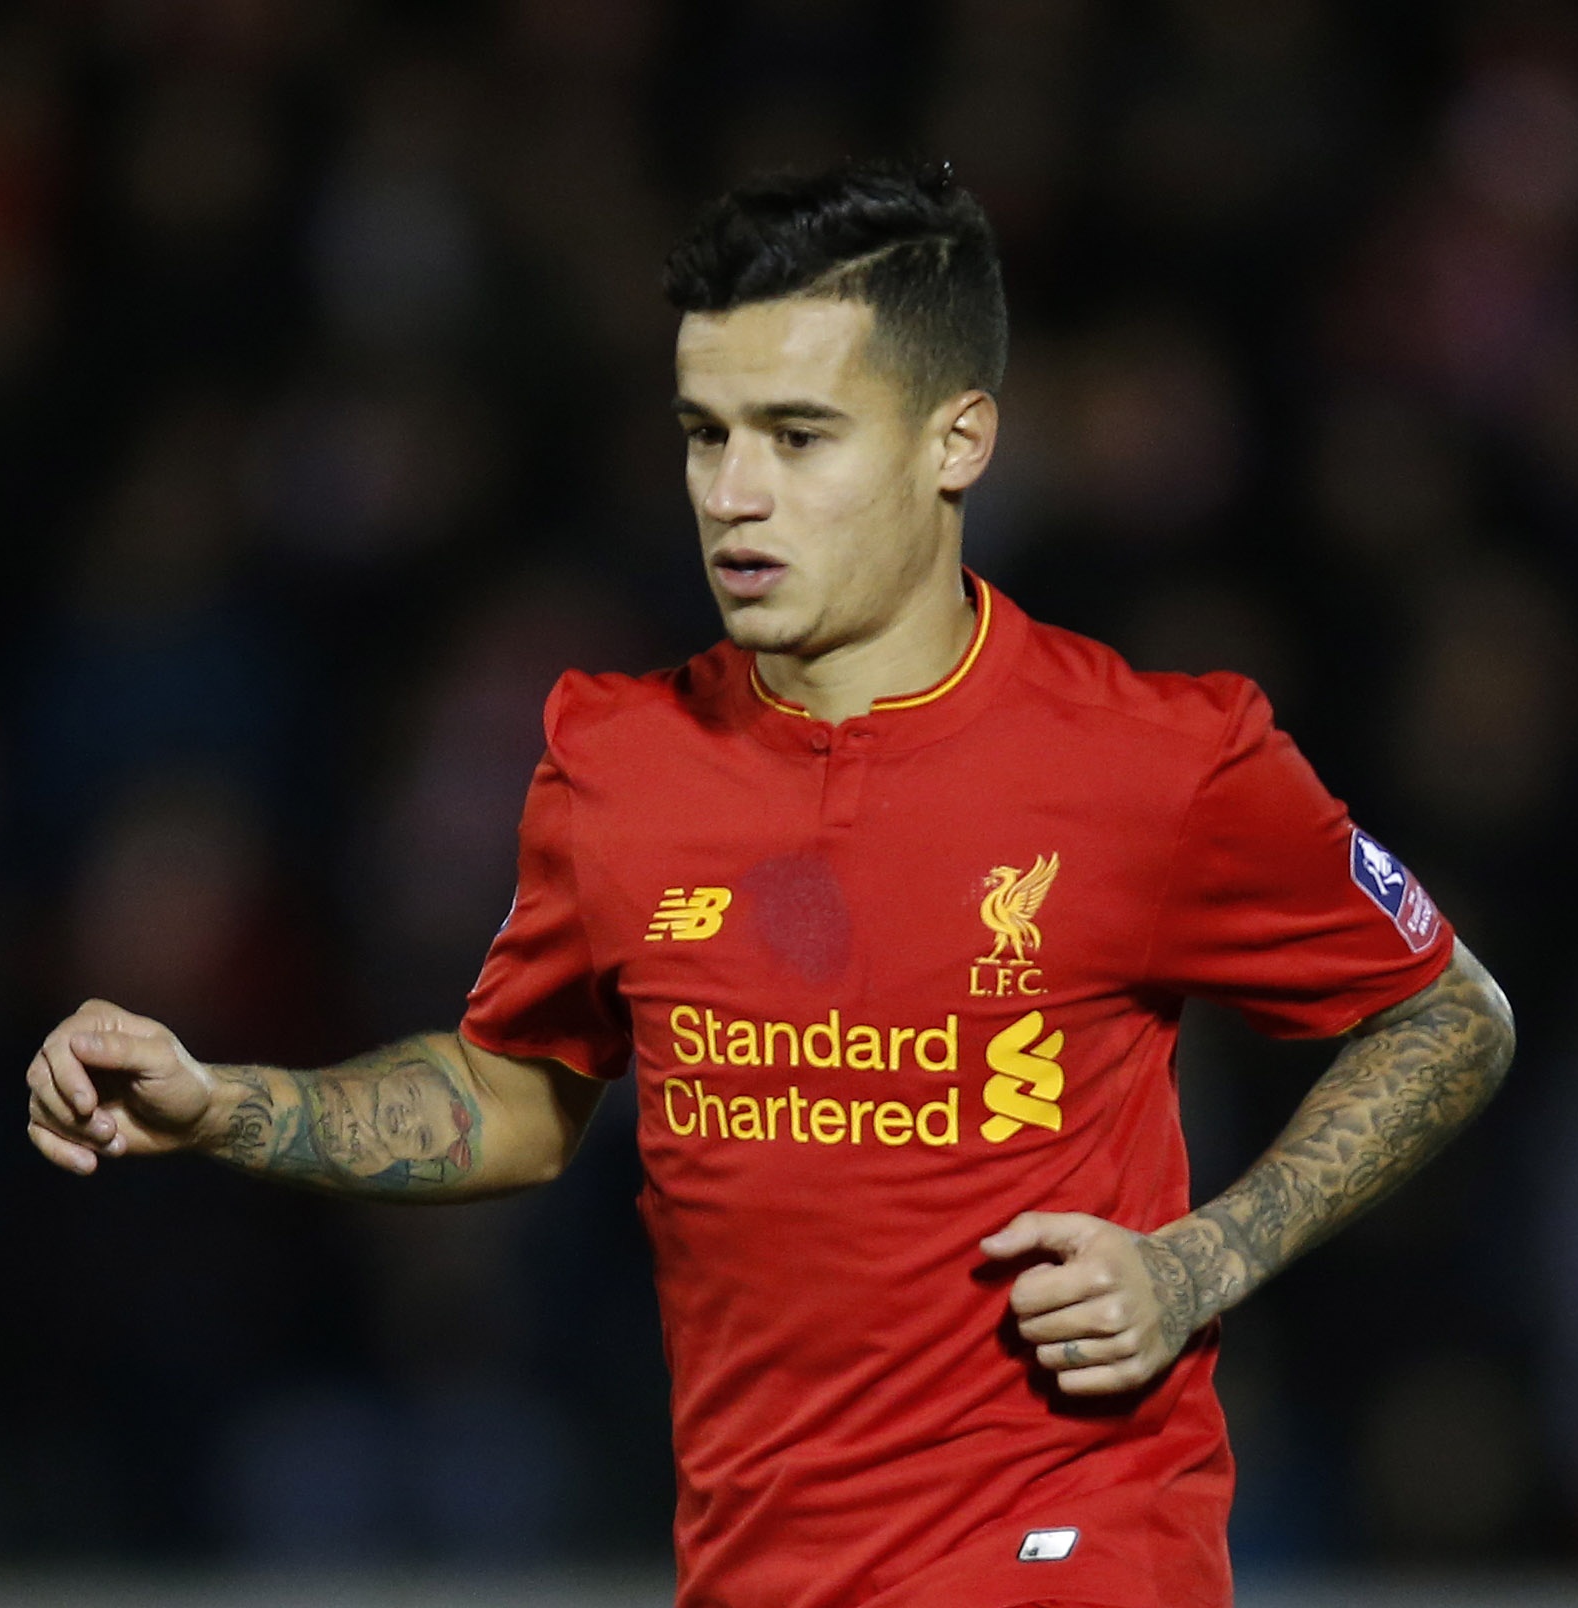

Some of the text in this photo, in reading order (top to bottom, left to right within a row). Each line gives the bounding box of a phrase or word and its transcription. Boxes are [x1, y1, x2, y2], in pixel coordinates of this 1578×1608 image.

[969, 966, 1048, 997] L.F.C.
[669, 1005, 959, 1072] Standard
[663, 1077, 960, 1147] Chartered
